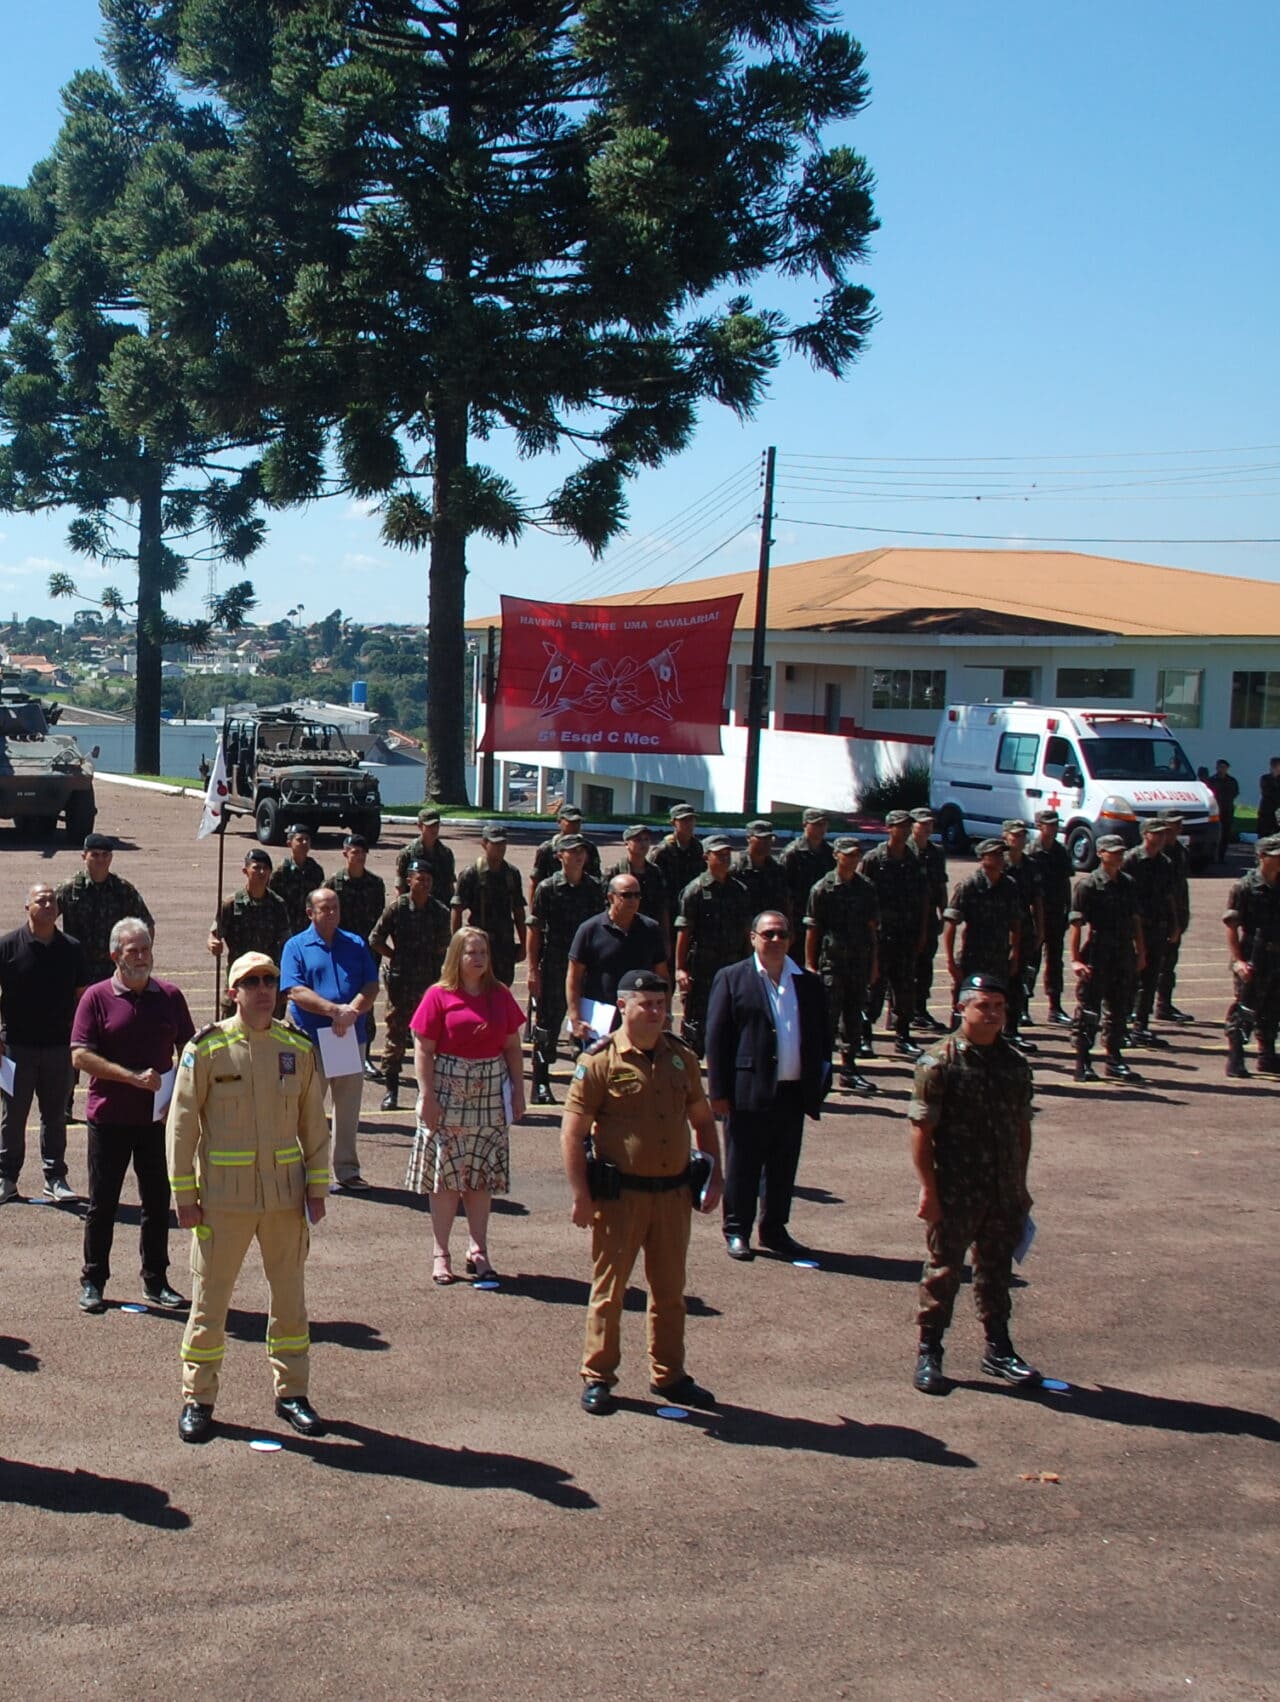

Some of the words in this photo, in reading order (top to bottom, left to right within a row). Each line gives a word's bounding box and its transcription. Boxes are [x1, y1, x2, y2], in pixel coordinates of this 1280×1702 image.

[520, 615, 563, 628] HAVERÁ
[571, 620, 617, 631] SEMPRE
[624, 621, 648, 630] UMA
[561, 731, 603, 744] Esqd
[607, 731, 619, 743] C
[624, 732, 660, 745] Mec
